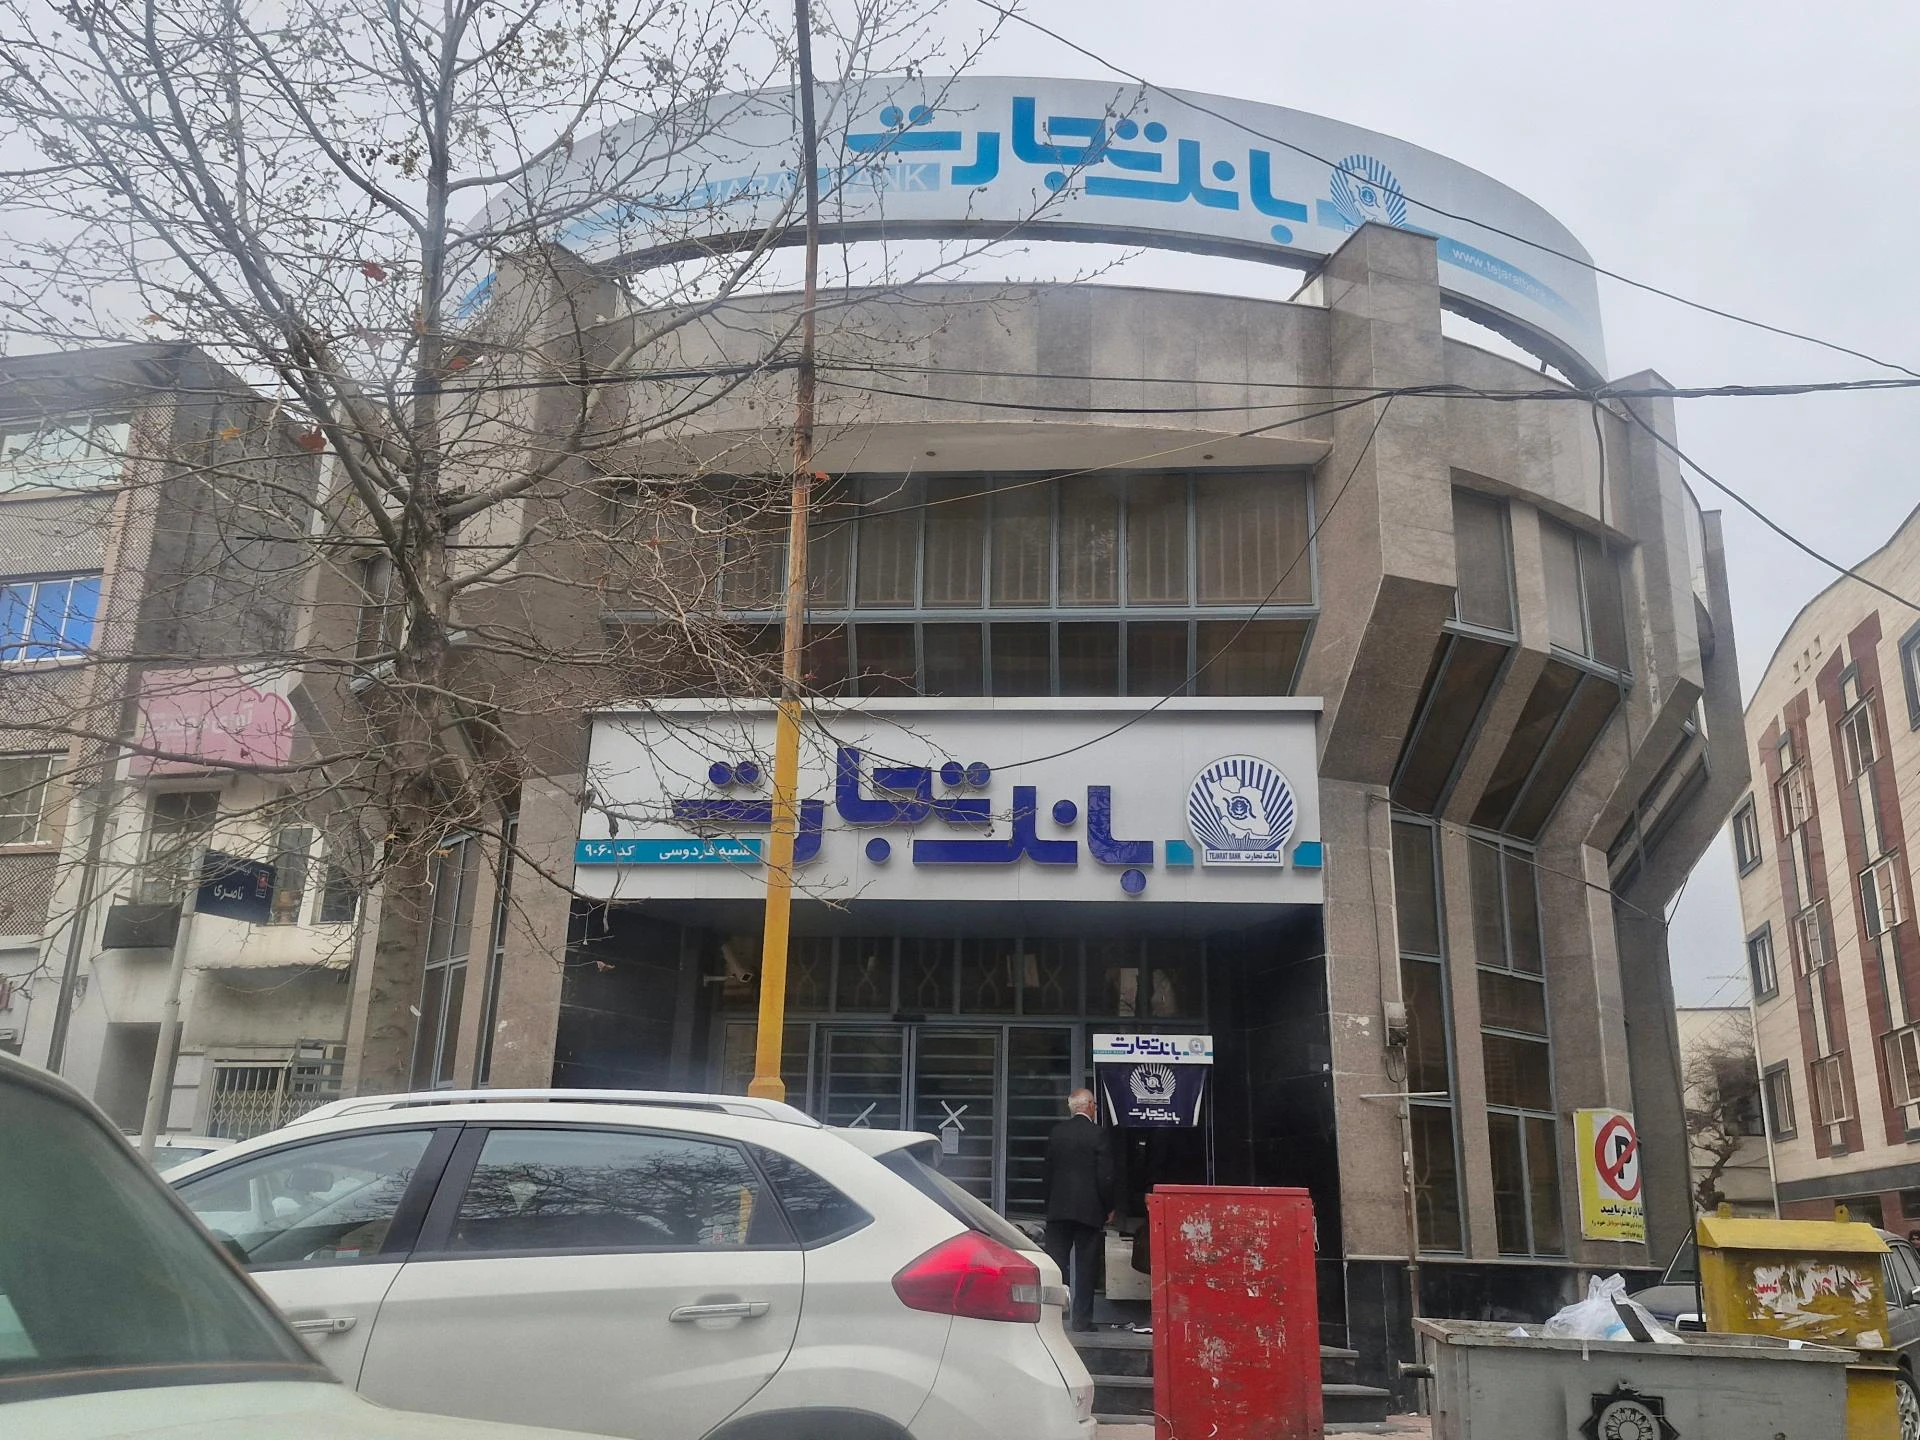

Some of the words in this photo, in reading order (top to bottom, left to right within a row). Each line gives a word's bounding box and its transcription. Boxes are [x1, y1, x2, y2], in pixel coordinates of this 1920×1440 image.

[846, 97, 1168, 191] تجارت
[1085, 139, 1308, 244] بانک
[672, 747, 991, 865] تجارت
[913, 785, 1154, 896] بانک
[617, 845, 635, 857] کد
[659, 843, 715, 860] فردوسی
[213, 884, 245, 901] ناصری
[1110, 1036, 1160, 1055] تجارت
[1147, 1042, 1182, 1060] بانک
[1128, 1107, 1165, 1120] تجارت
[1153, 1111, 1181, 1125] بانک
